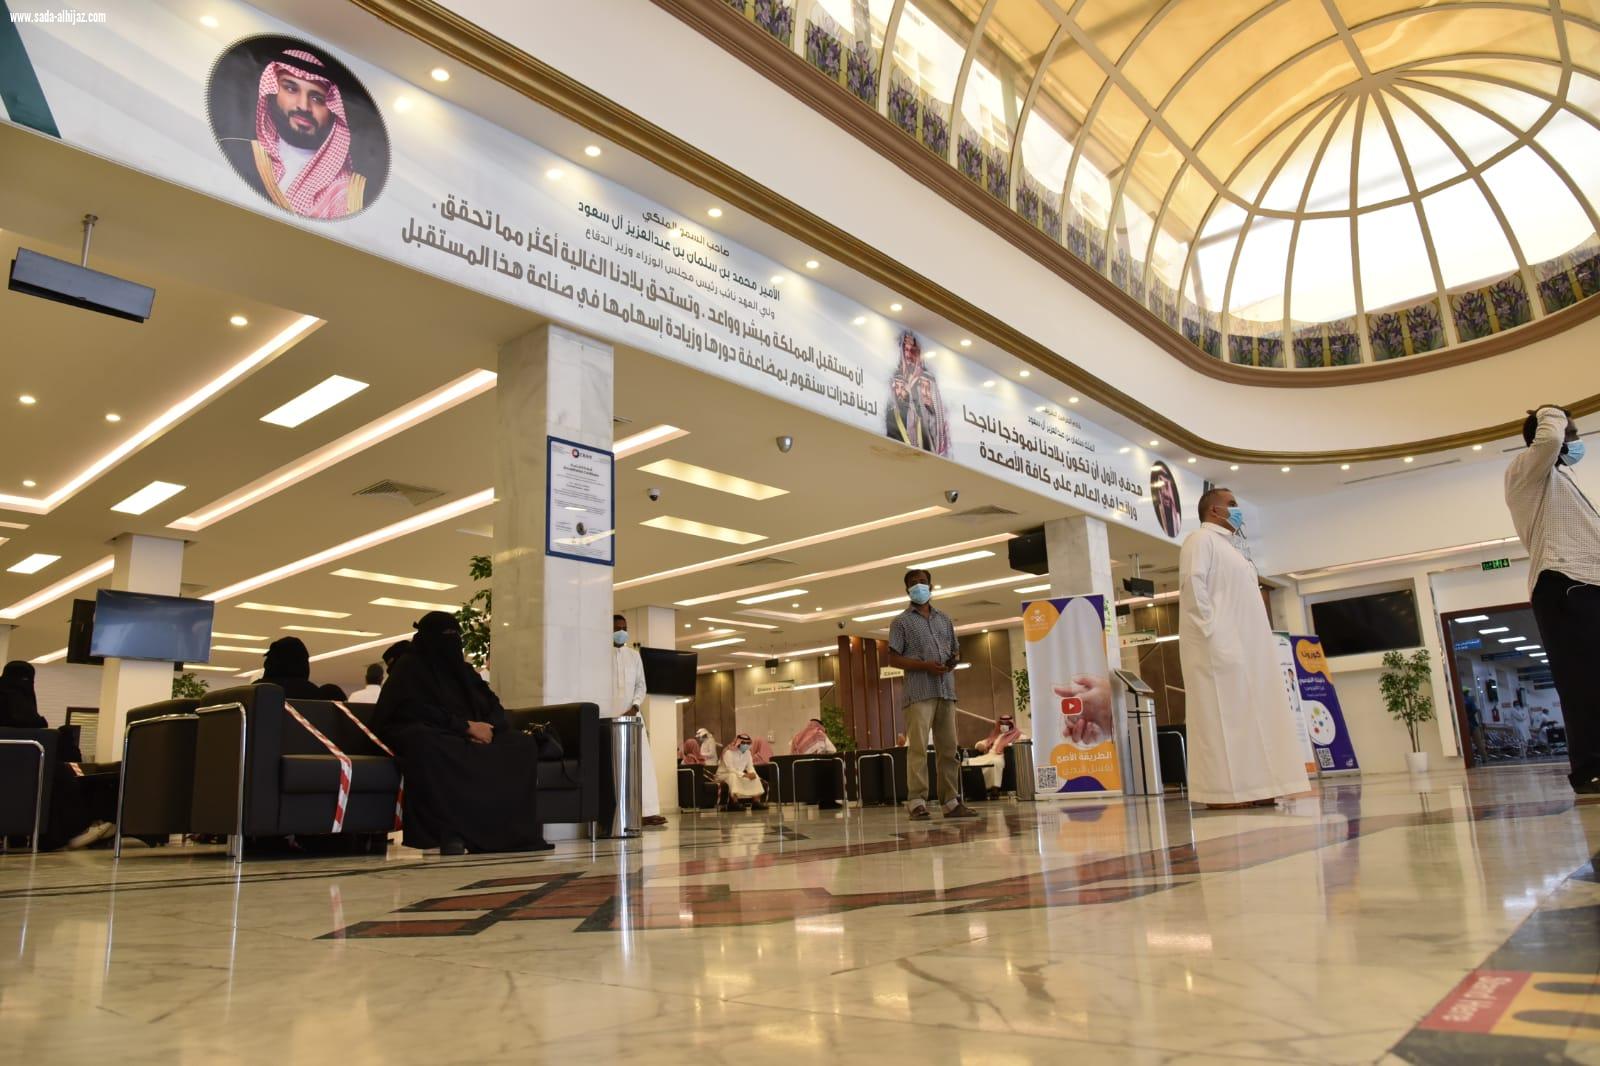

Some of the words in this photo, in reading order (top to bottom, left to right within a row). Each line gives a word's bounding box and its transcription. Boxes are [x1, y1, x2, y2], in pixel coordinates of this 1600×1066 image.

[578, 201, 610, 223] سعود
[612, 215, 623, 230] آل
[642, 211, 677, 230] الملكي
[496, 213, 524, 246] مما
[585, 227, 613, 247] الدفاع
[625, 220, 671, 251] عبدالعزيز
[401, 217, 489, 267] المستقبل
[527, 226, 558, 258] أكثر
[615, 241, 634, 258] وزير
[672, 246, 685, 260] بن
[706, 240, 730, 257] صاحب
[493, 250, 523, 280] هذا
[561, 242, 607, 277] الغالية
[635, 251, 663, 269] الوزراء
[687, 251, 717, 273] سلمان
[526, 263, 574, 299] صناعة
[610, 261, 643, 296] بلادنا
[665, 264, 694, 282] مجلس
[719, 268, 731, 279] بن
[732, 272, 757, 290] محمد
[696, 278, 718, 294] رئيس
[719, 288, 737, 301] نائب
[759, 284, 780, 302] الأمير
[577, 287, 600, 309] في
[646, 278, 700, 319] وتستحق
[738, 296, 758, 312] العهد
[603, 292, 663, 338] إسهامها
[759, 307, 775, 320] ولي
[666, 318, 702, 352] وزيادة
[743, 319, 771, 347] مبشر
[704, 331, 736, 362] دورها
[773, 331, 814, 363] المملكة
[738, 346, 788, 385] بمضاعفة
[815, 351, 854, 381] مستقبل
[790, 371, 826, 396] سنقوم
[827, 385, 855, 407] قدرات
[856, 393, 878, 416] لدينا
[963, 404, 997, 434] ناجحا
[998, 420, 1038, 452] نموذجا
[979, 441, 1024, 474] الأصعدة
[1039, 438, 1064, 467] بلادنا
[1066, 450, 1090, 474] تكون
[1025, 460, 1051, 484] كافة
[1091, 459, 1100, 480] أن
[1101, 465, 1117, 487] الأول
[1053, 474, 1072, 492] على
[1074, 482, 1100, 503] العالم
[1119, 476, 1143, 497] هدفي
[1101, 493, 1116, 509] في
